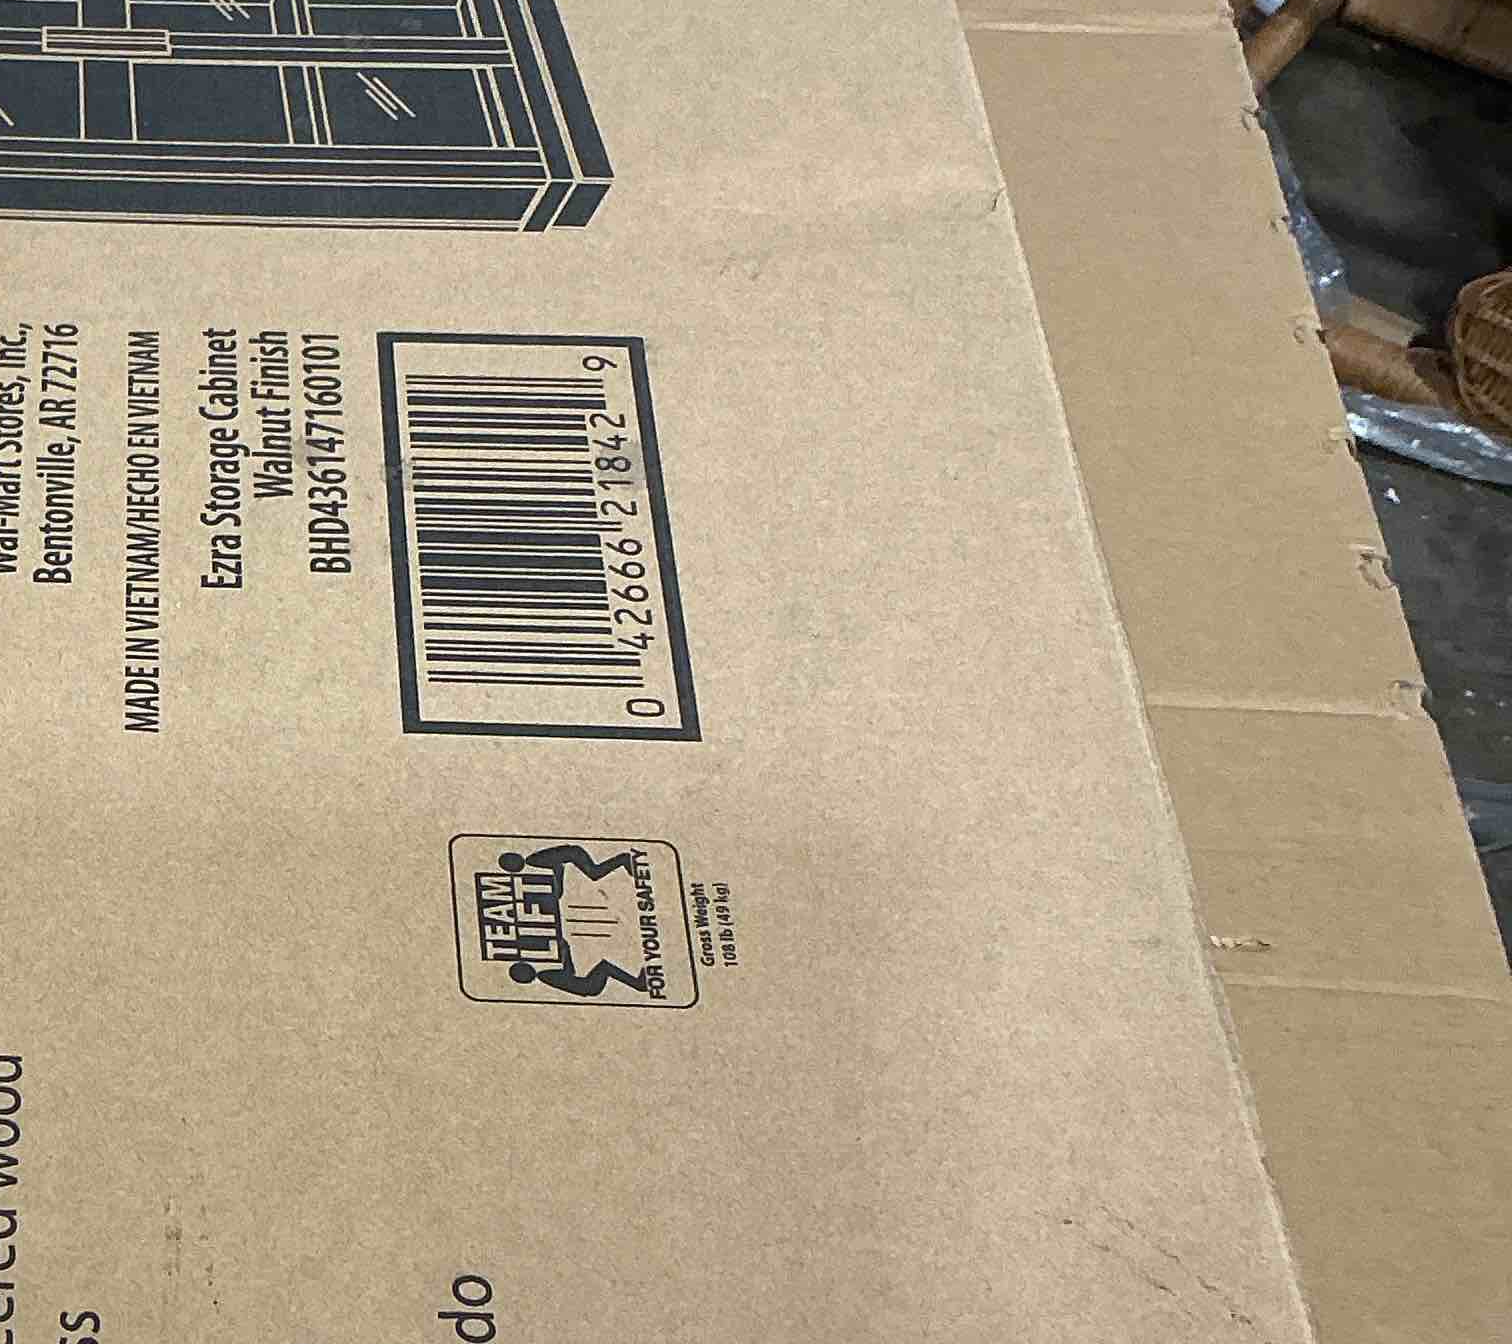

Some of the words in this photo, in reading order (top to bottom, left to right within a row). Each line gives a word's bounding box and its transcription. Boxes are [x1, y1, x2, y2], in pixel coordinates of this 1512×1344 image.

[41, 324, 78, 392] 72716
[128, 332, 160, 418] VIETNAM
[198, 328, 238, 420] Cabinet
[249, 331, 289, 400] Finish
[582, 355, 617, 371] 9
[39, 399, 76, 430] AR
[128, 423, 159, 448] EN
[200, 428, 250, 527] Storage
[252, 407, 293, 498] Walnut
[301, 335, 351, 573] BHD436147160101
[589, 413, 638, 516] 21842
[33, 436, 81, 583] Bentonville,
[126, 454, 161, 632] VIETNAM/HECHO
[201, 535, 242, 588] Ezra
[606, 538, 654, 649] 42666
[125, 638, 159, 660] IN
[125, 666, 159, 733] MADE
[626, 697, 665, 718] 0
[631, 848, 655, 912] SAFETY
[690, 882, 710, 928] Weight
[480, 875, 517, 960] TEAM
[517, 874, 561, 960] LIFT
[638, 915, 662, 961] YOUR
[696, 931, 716, 967] Gross
[646, 965, 667, 1000] FOR
